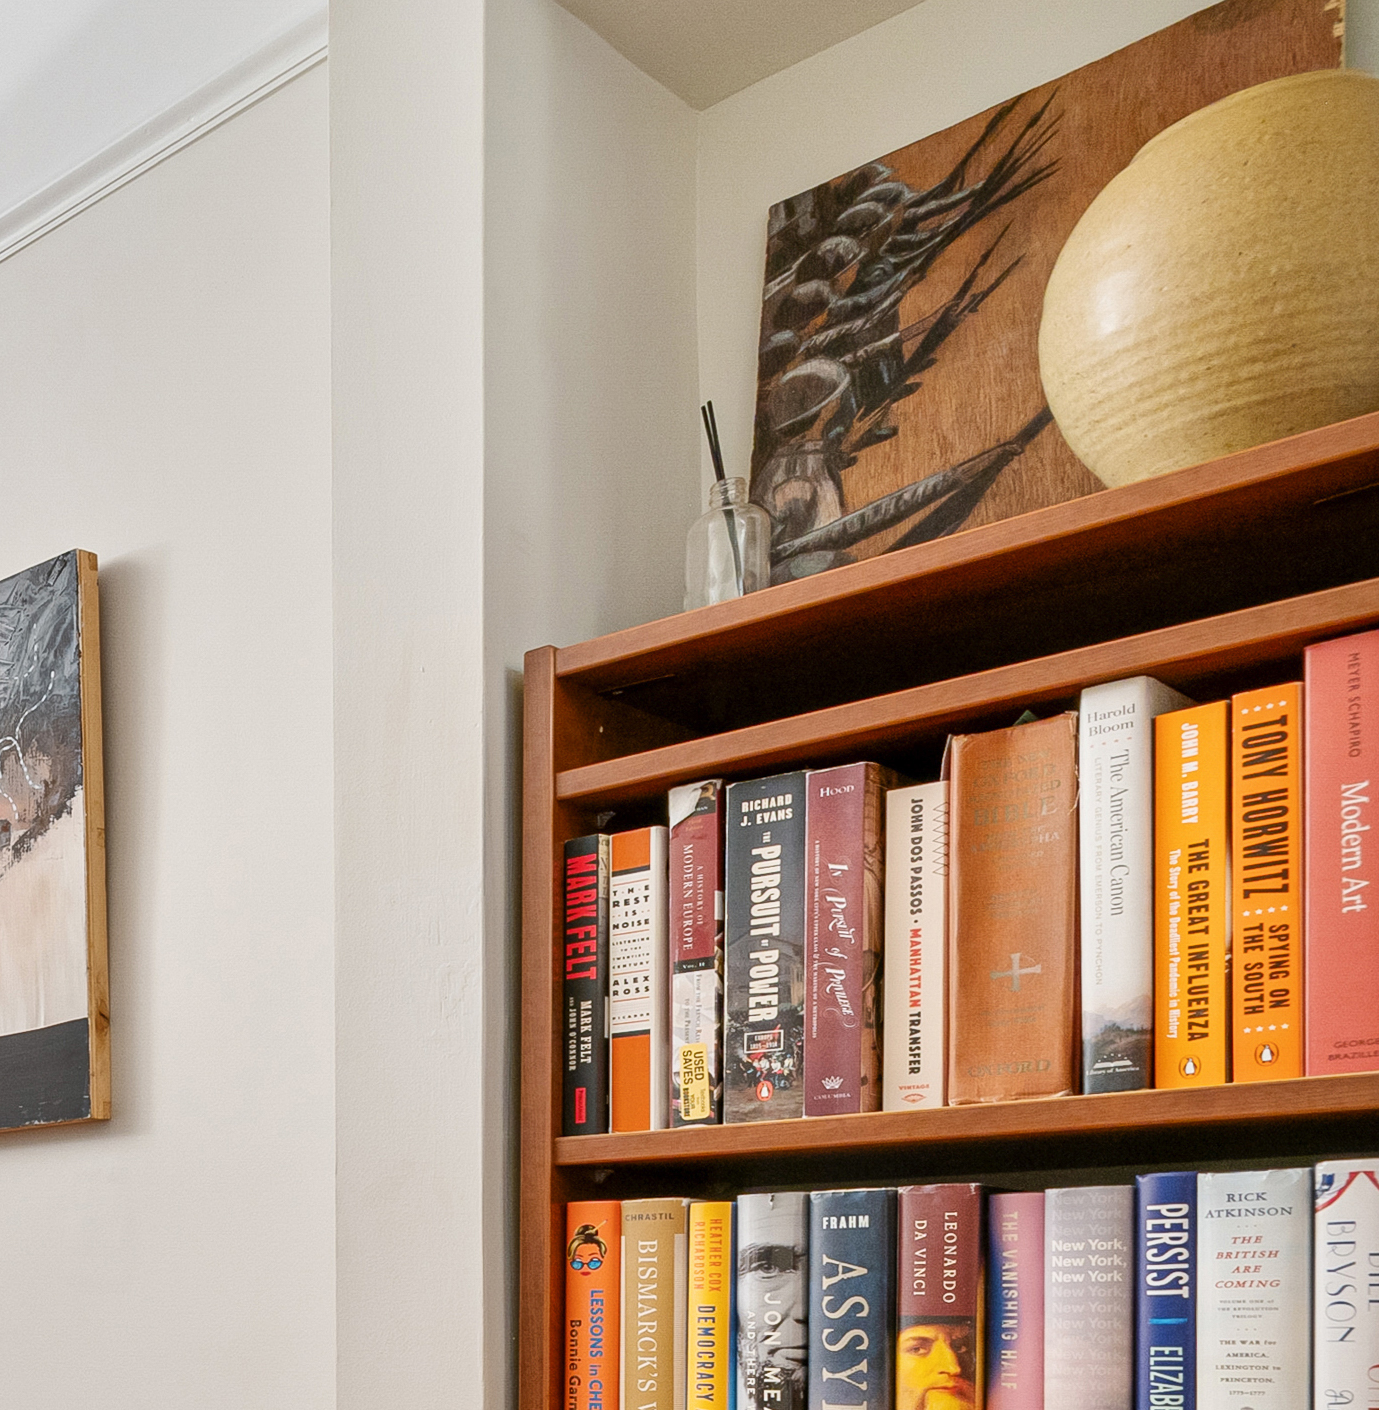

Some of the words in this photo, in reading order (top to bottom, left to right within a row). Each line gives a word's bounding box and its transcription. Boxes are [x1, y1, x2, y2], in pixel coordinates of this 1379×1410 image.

[1348, 652, 1360, 693] MEYER
[1087, 703, 1136, 723] Harold
[1089, 720, 1134, 737] Bloom
[1348, 696, 1361, 758] SCHAPIRO
[1181, 723, 1198, 758] JOHN
[1242, 714, 1288, 780] TONY
[1181, 761, 1198, 777] M.
[911, 799, 923, 832] JOHN
[1181, 781, 1198, 824] BARRY
[1242, 788, 1289, 899] HORWITZ
[1341, 780, 1370, 872] Modern
[910, 837, 923, 863] DOS
[1188, 838, 1209, 874] THE
[566, 854, 597, 922] MARK
[683, 844, 693, 900] MODERN
[750, 844, 781, 936] PURSUIT
[910, 867, 923, 916] PASSOS
[613, 895, 649, 908] REST
[1188, 881, 1209, 935] GREAT
[1342, 877, 1370, 914] Art
[612, 918, 649, 930] NOISE
[683, 903, 693, 951] EUROPE
[1244, 923, 1264, 953] THE
[566, 925, 597, 980] FELT
[909, 929, 922, 1008] MANHATTAN
[1269, 924, 1289, 980] SPYING
[613, 975, 649, 986] ALEX
[613, 986, 649, 997] ROSS
[749, 949, 779, 1022] POWER
[1188, 944, 1209, 1041] INFLUENZA
[1244, 962, 1264, 1015] SOUTH
[1269, 988, 1289, 1009] ON
[909, 1012, 921, 1075] TRANSFER
[683, 1050, 693, 1085] SAVES
[694, 1052, 704, 1081] USED
[625, 1213, 674, 1221] CHRASTIL
[1205, 1206, 1292, 1219] ATKINSON
[1226, 1192, 1267, 1202] RICK
[710, 1219, 722, 1267] HEATHER
[822, 1215, 869, 1229] FRAHM
[914, 1219, 927, 1241] DA
[1231, 1236, 1263, 1244] THE
[694, 1222, 705, 1290] RICHARDSON
[943, 1211, 958, 1303] LEONARDO
[1052, 1240, 1085, 1252] New
[1088, 1238, 1127, 1252] York,
[1146, 1203, 1189, 1298] PERSIST
[1216, 1250, 1279, 1260] BRITISH
[709, 1270, 722, 1292] COX
[913, 1248, 926, 1296] VINCI
[1215, 1280, 1281, 1289] COMING
[1231, 1265, 1262, 1273] ARE
[1325, 1221, 1357, 1343] BRYSON
[590, 1290, 604, 1358] LESSONS
[637, 1239, 658, 1392] BISMARCK'S
[763, 1293, 782, 1346] JON
[569, 1320, 581, 1370] Bonnie
[696, 1305, 716, 1402] DEMOCRACY
